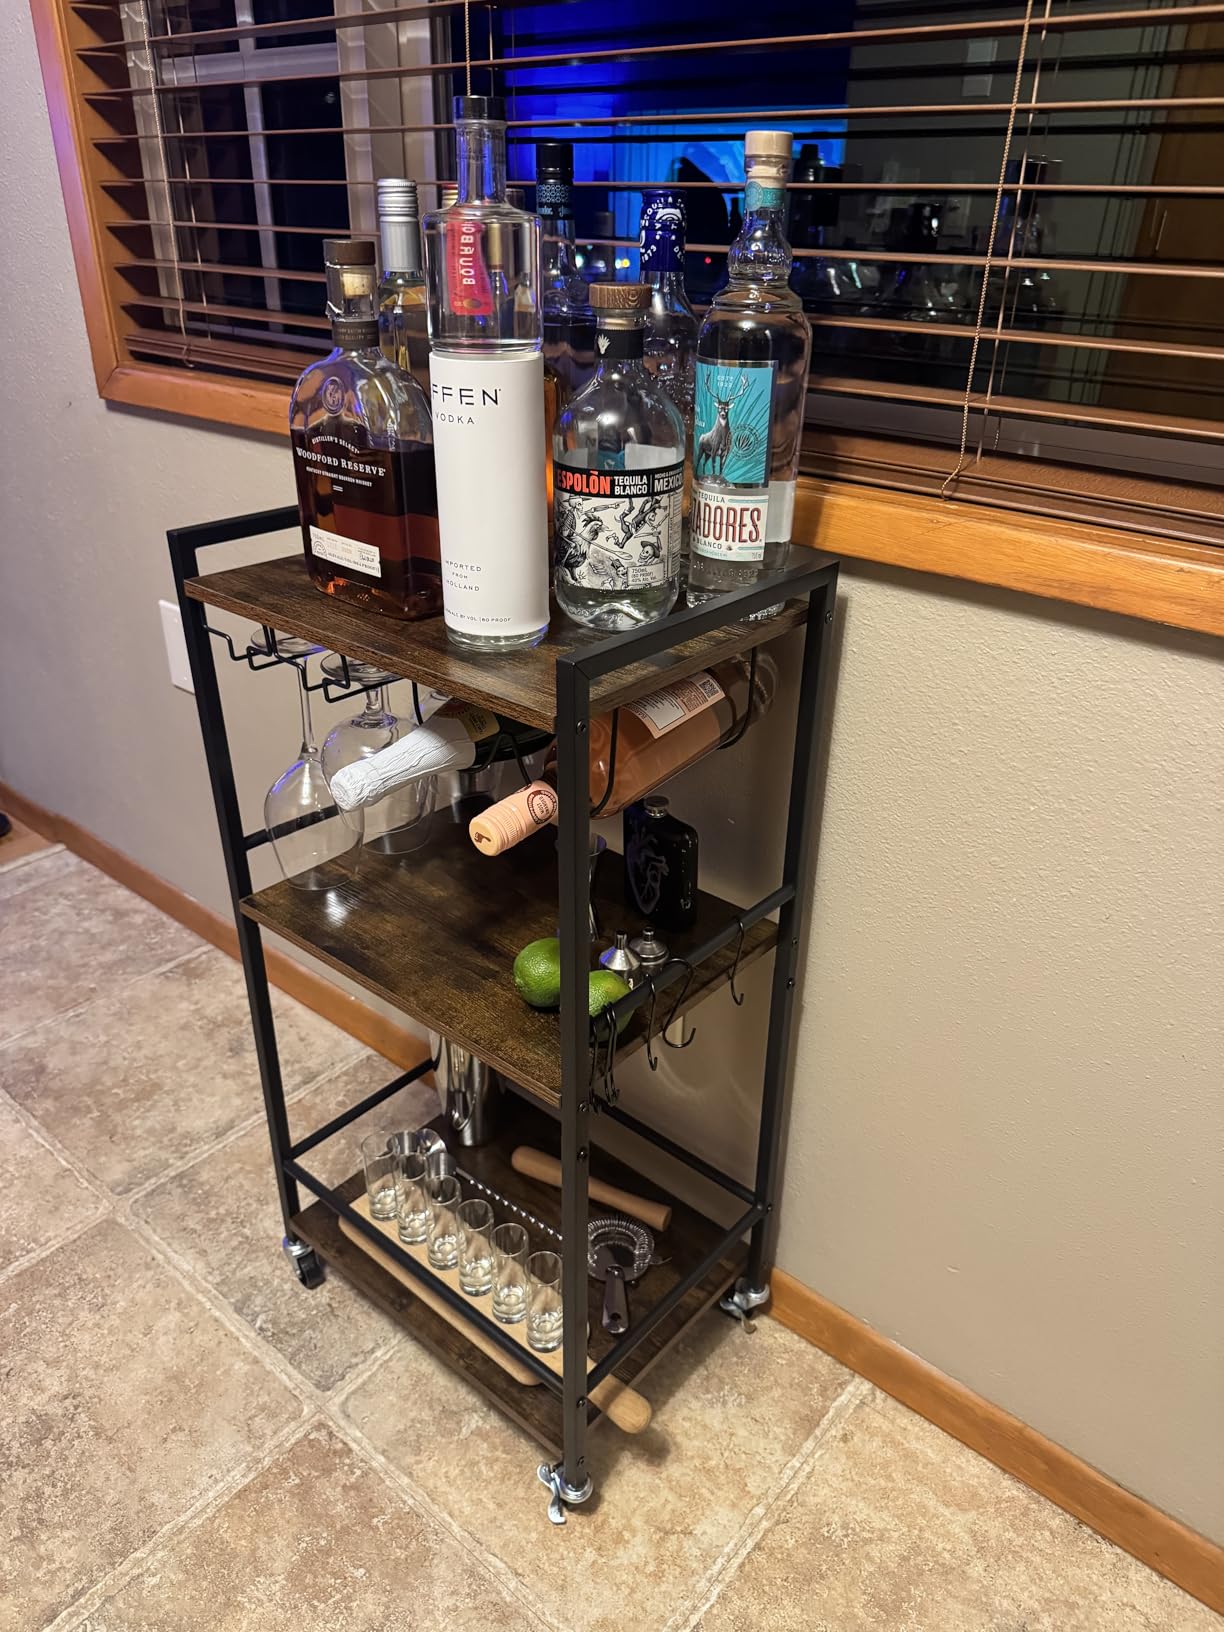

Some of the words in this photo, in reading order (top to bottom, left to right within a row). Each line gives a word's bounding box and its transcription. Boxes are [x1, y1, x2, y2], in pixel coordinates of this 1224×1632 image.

[435, 411, 475, 425] VODKA
[295, 446, 339, 467] WOODFORD
[340, 458, 386, 477] RESERVE
[614, 475, 648, 486] TEQUILA
[614, 485, 648, 496] BLANCO
[697, 490, 726, 504] TEQUILA
[696, 537, 723, 550] BLANCO
[451, 571, 468, 579] FROM
